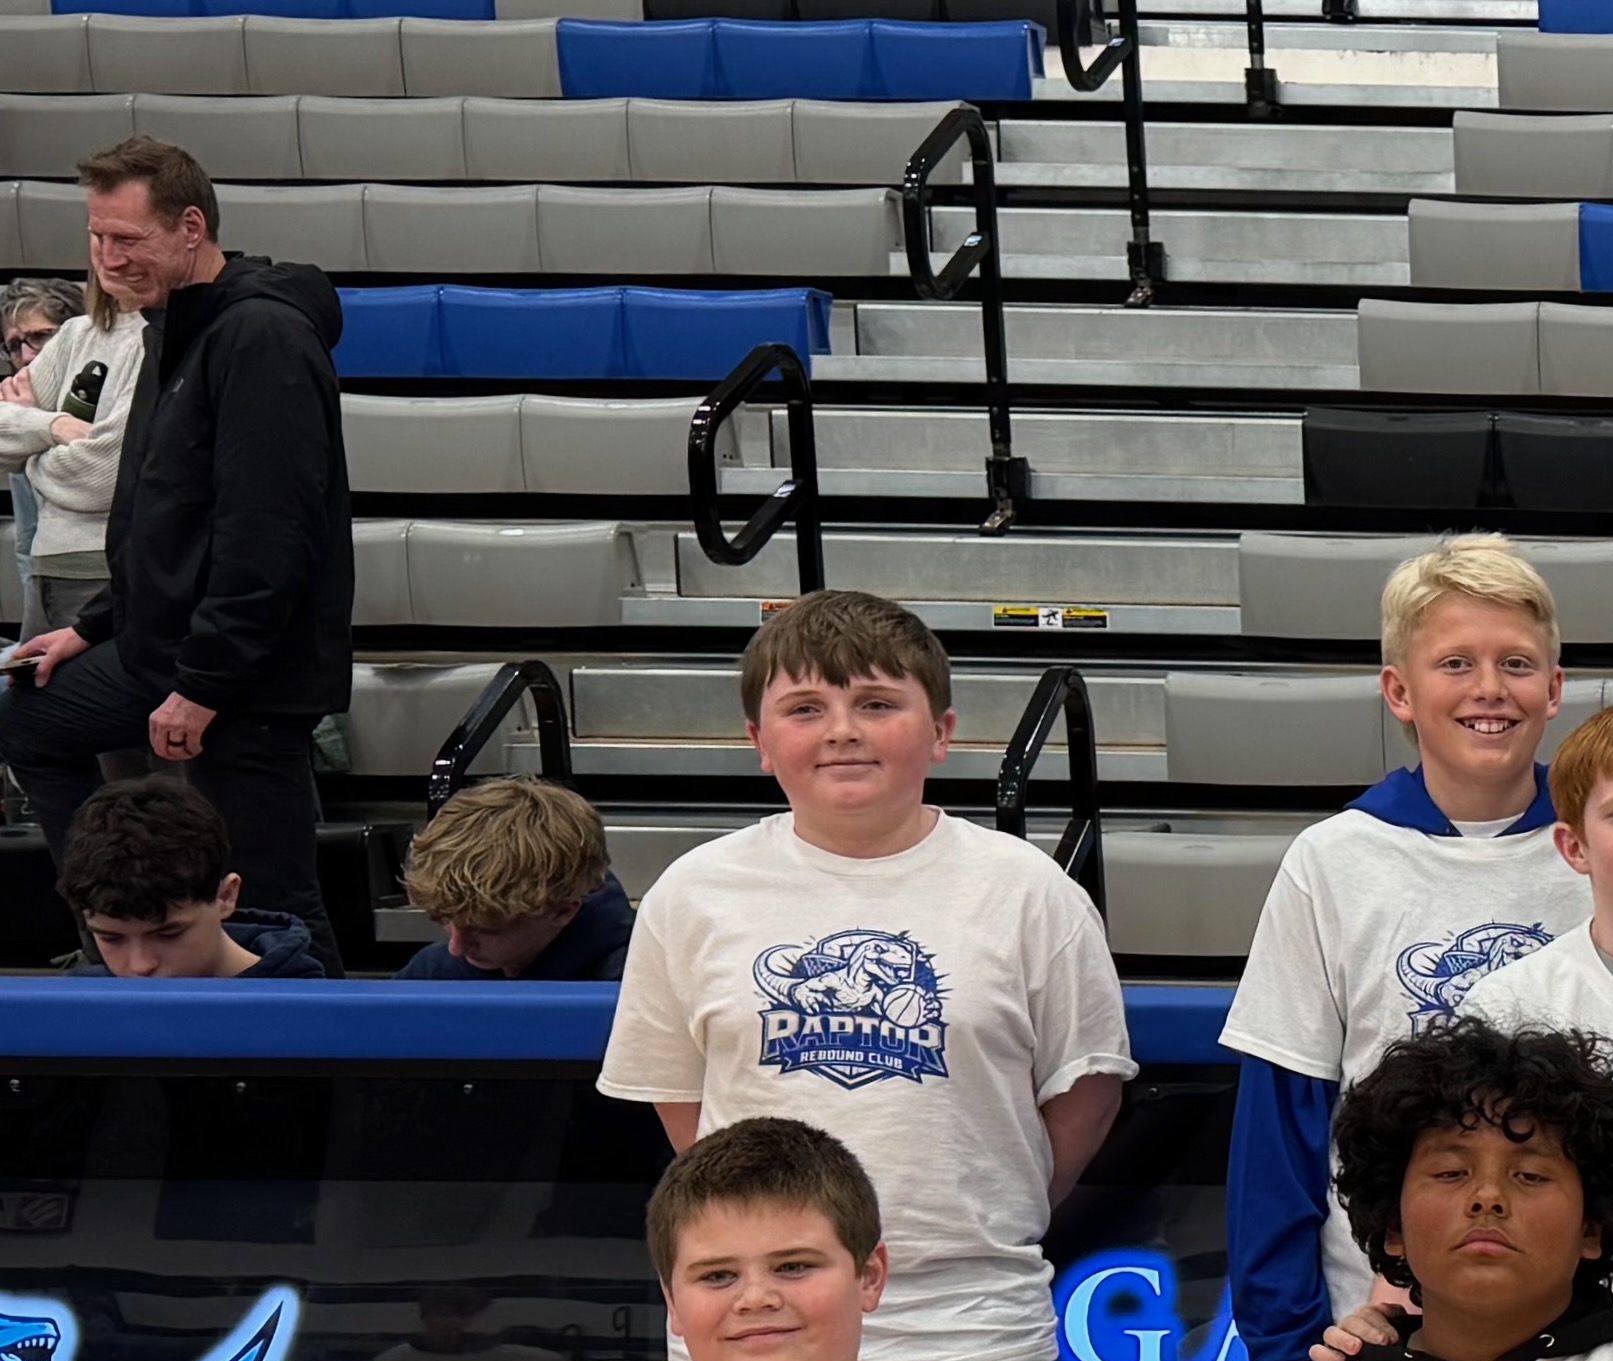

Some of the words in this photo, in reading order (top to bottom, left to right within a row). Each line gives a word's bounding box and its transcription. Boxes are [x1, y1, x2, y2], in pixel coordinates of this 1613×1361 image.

[762, 1010, 946, 1071] RAPTOR
[800, 1050, 864, 1063] REBOUND
[868, 1052, 903, 1069] CLUB
